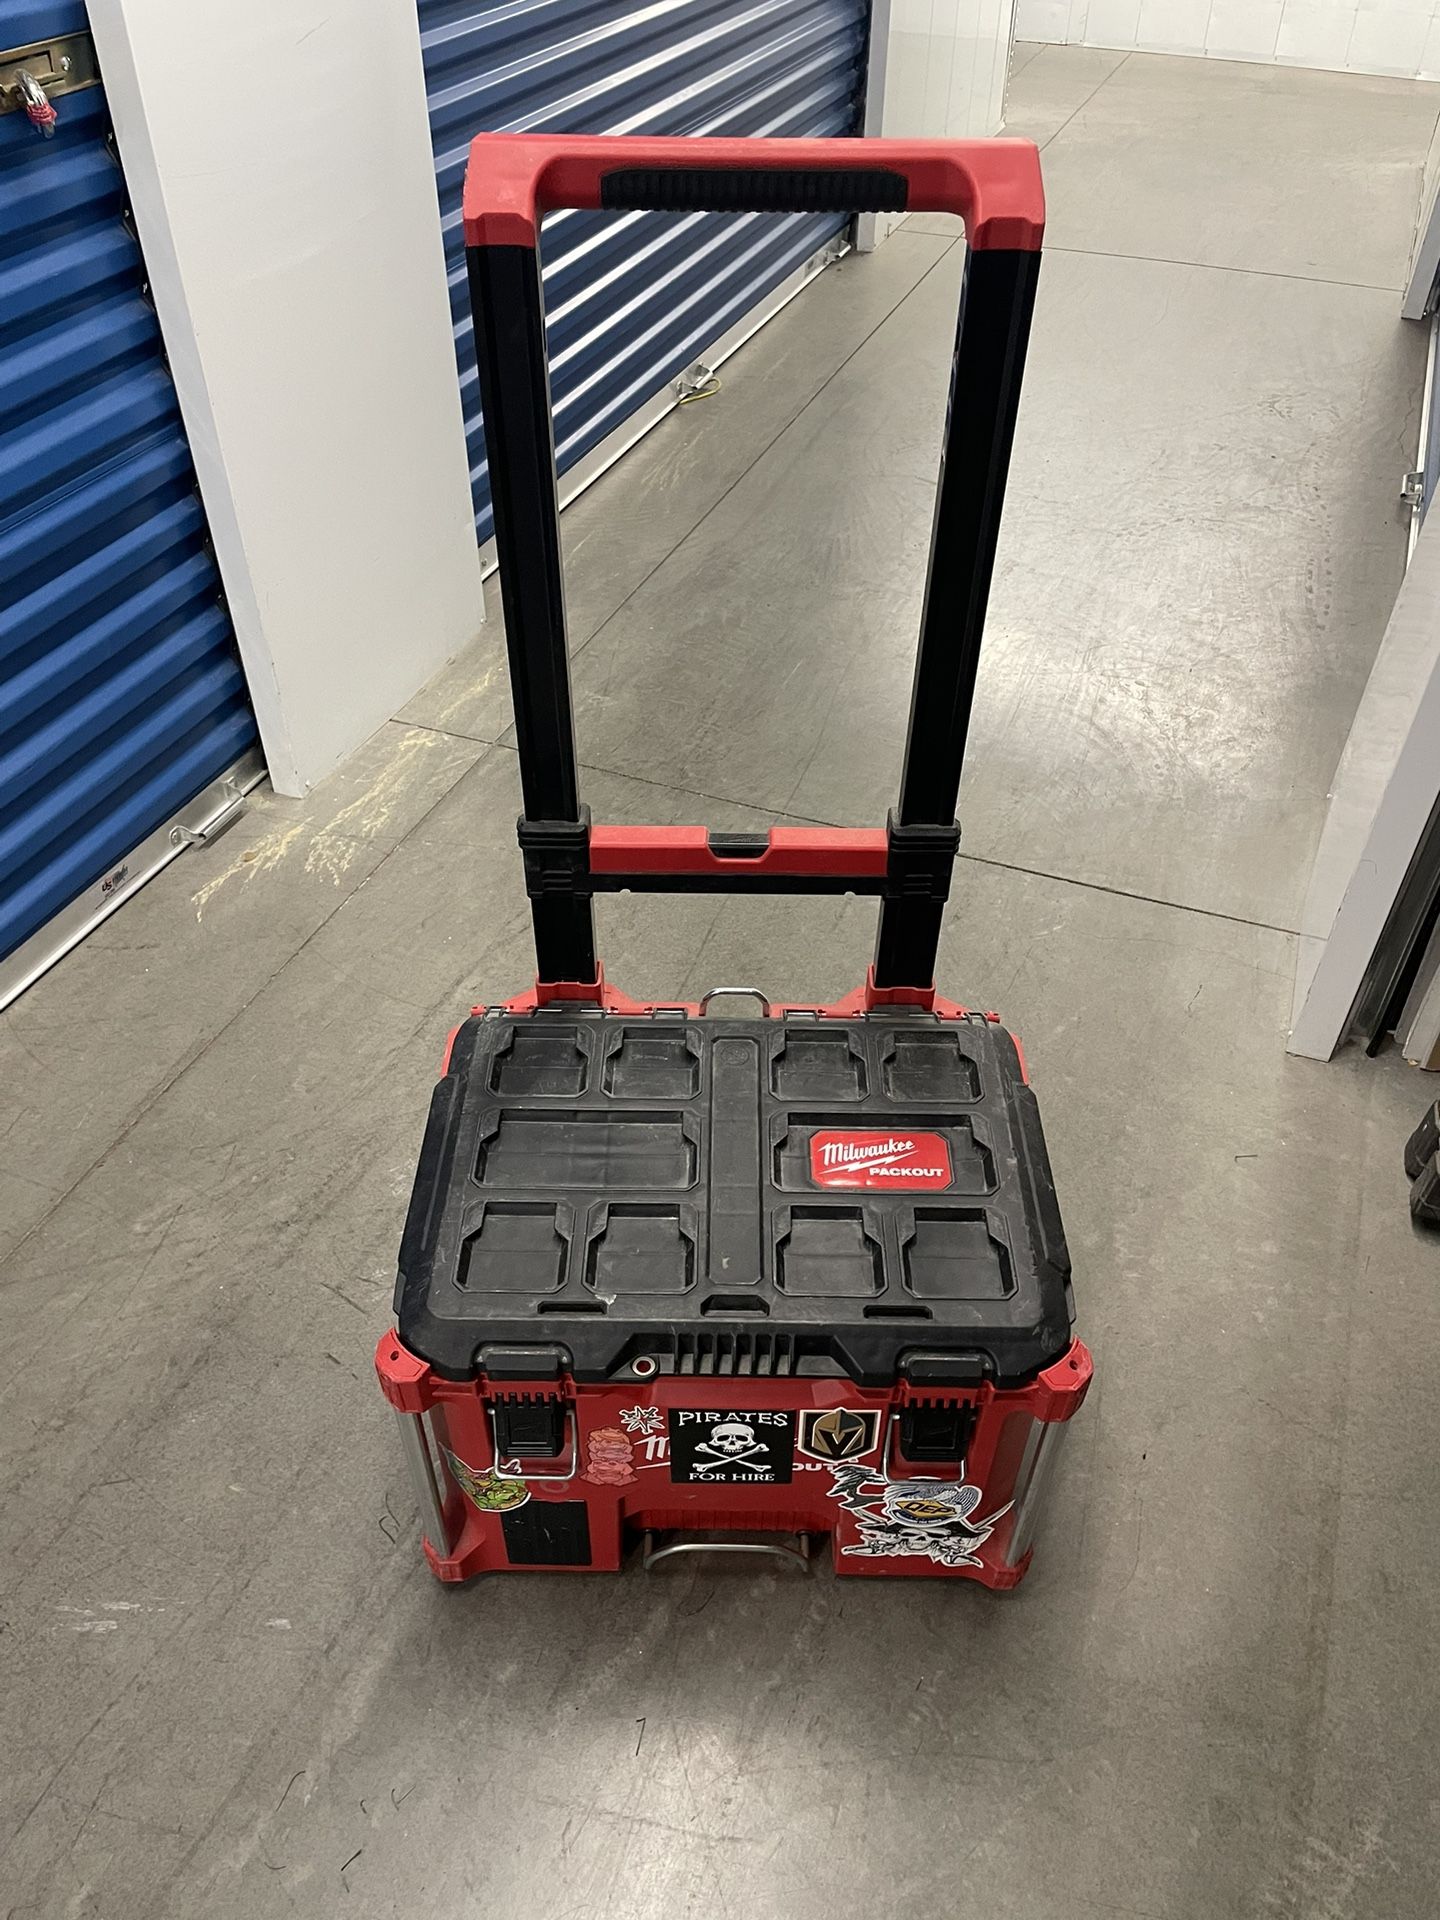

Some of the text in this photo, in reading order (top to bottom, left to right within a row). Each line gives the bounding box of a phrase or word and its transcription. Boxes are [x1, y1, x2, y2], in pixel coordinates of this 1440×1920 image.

[817, 1138, 916, 1166] Milwaukee
[869, 1167, 944, 1177] PACKOUT
[678, 1411, 788, 1427] PIRATES
[689, 1472, 775, 1482] FOR HIRE
